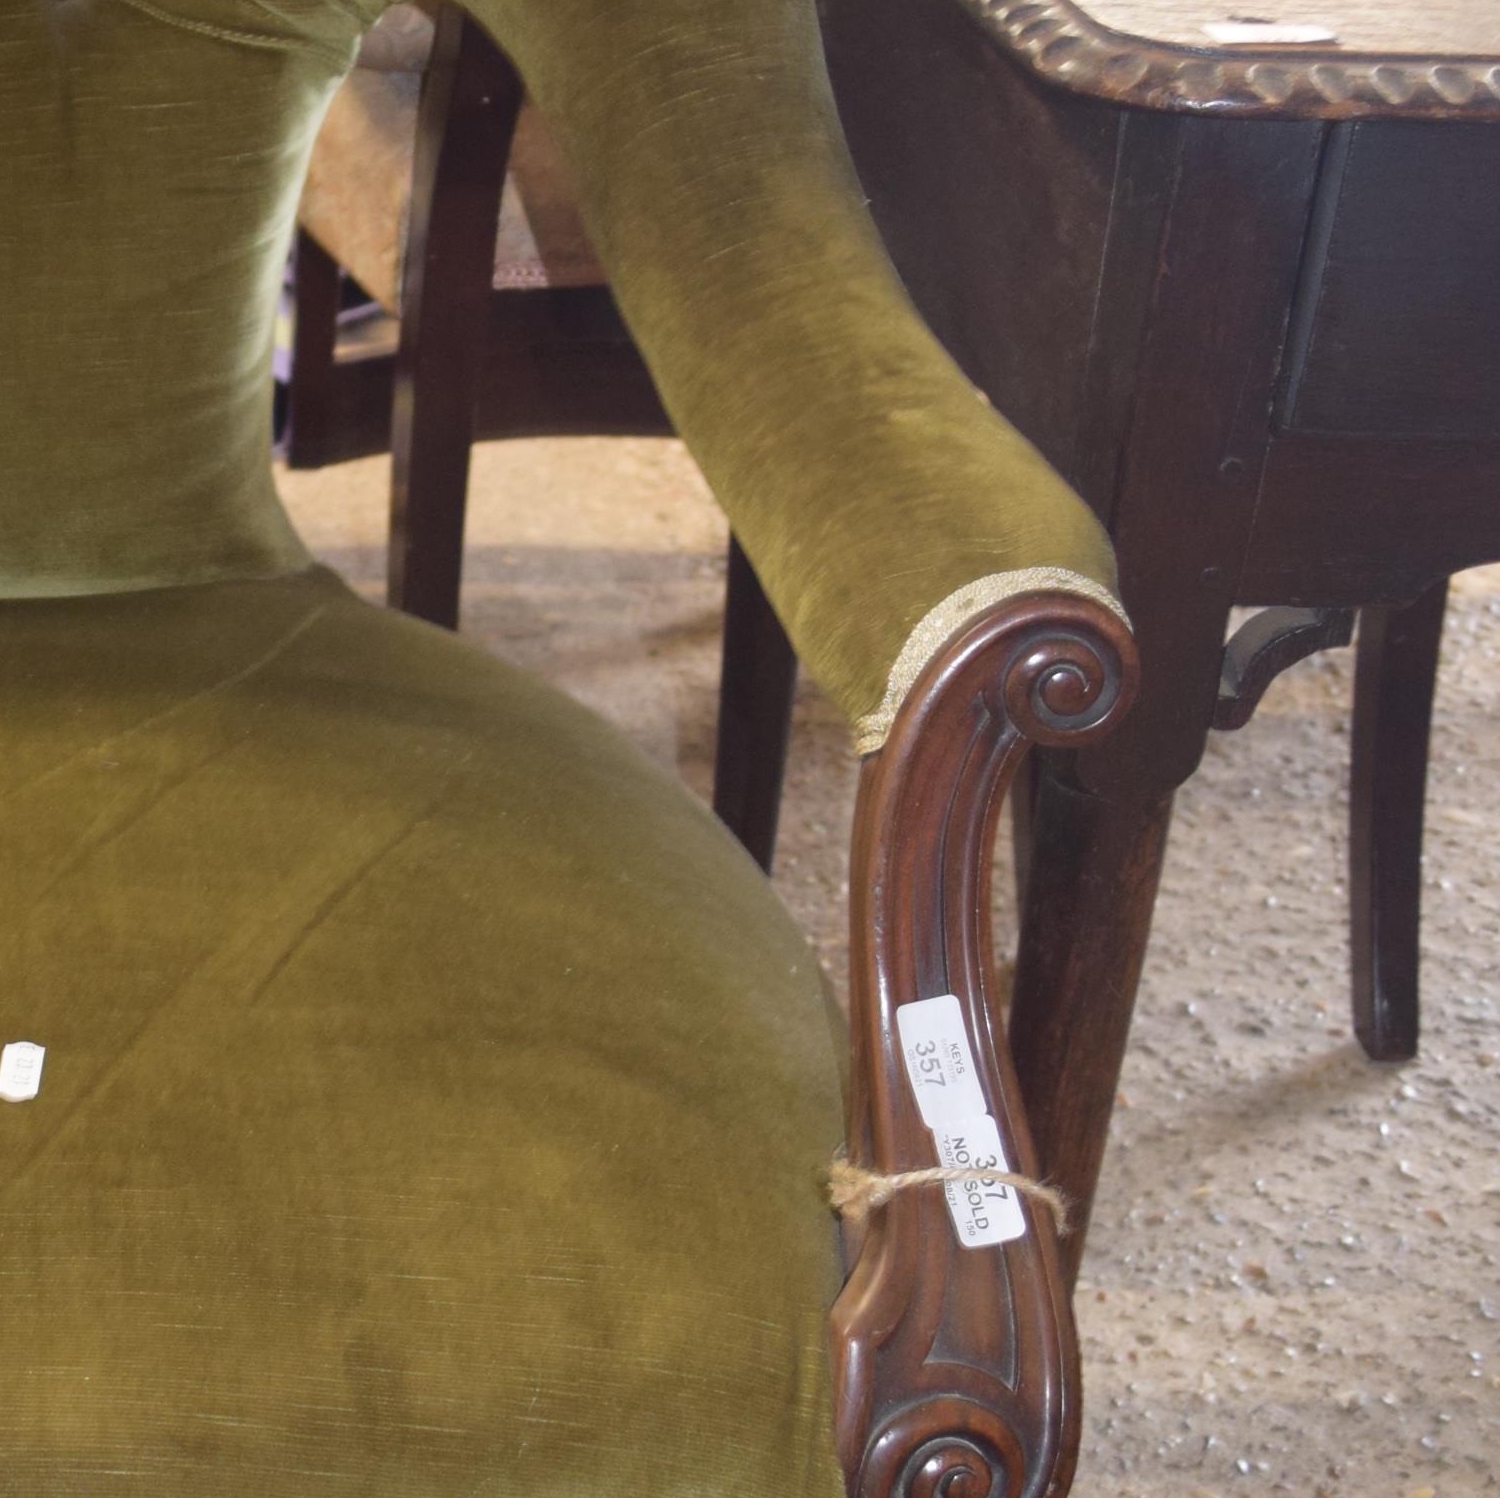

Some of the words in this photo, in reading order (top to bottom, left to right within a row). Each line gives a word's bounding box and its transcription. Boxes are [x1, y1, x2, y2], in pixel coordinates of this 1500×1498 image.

[915, 1040, 946, 1087] 357
[949, 1042, 965, 1074] KEYS
[952, 1137, 973, 1169] NO
[964, 1180, 989, 1230] SOLD
